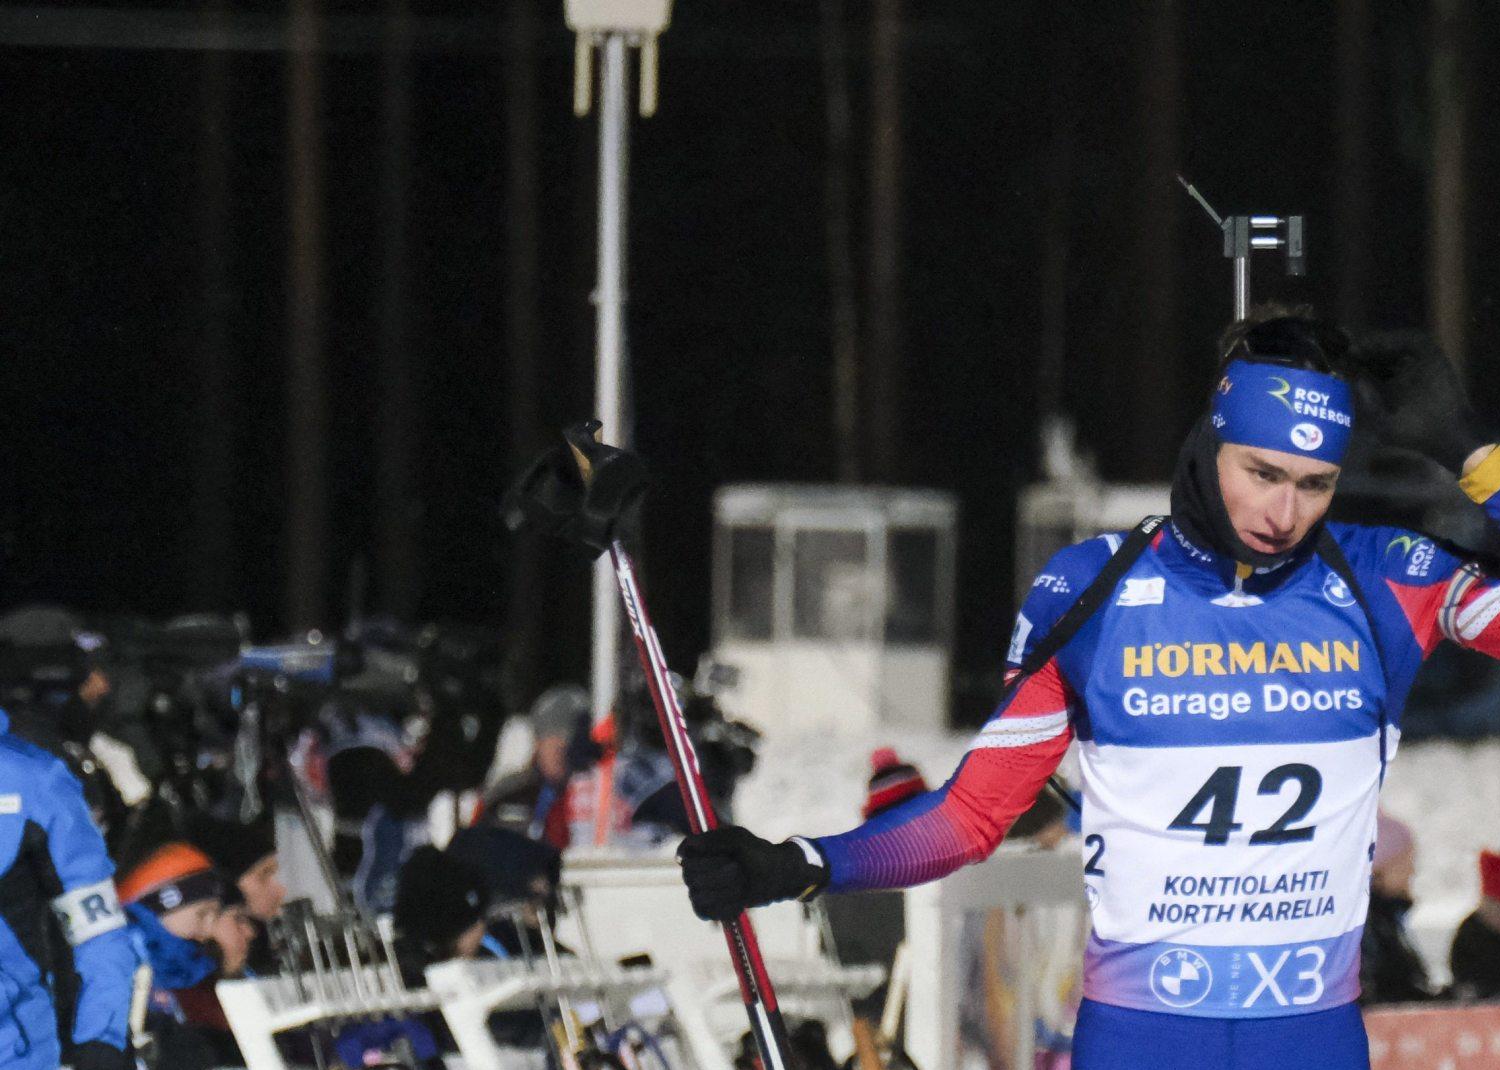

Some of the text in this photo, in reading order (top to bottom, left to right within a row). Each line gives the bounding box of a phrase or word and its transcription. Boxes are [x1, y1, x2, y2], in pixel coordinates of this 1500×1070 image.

[1294, 387, 1330, 406] ROY
[1407, 543, 1429, 575] ROY
[1123, 641, 1360, 677] HÖRMANN
[1123, 684, 1363, 720] Garage Doors
[1166, 762, 1323, 846] 42
[1164, 870, 1329, 896] KONTIOLAHTI
[1148, 896, 1335, 924] NORTH KARELIA
[1160, 951, 1205, 970] BMW
[1242, 945, 1326, 1008] X3
